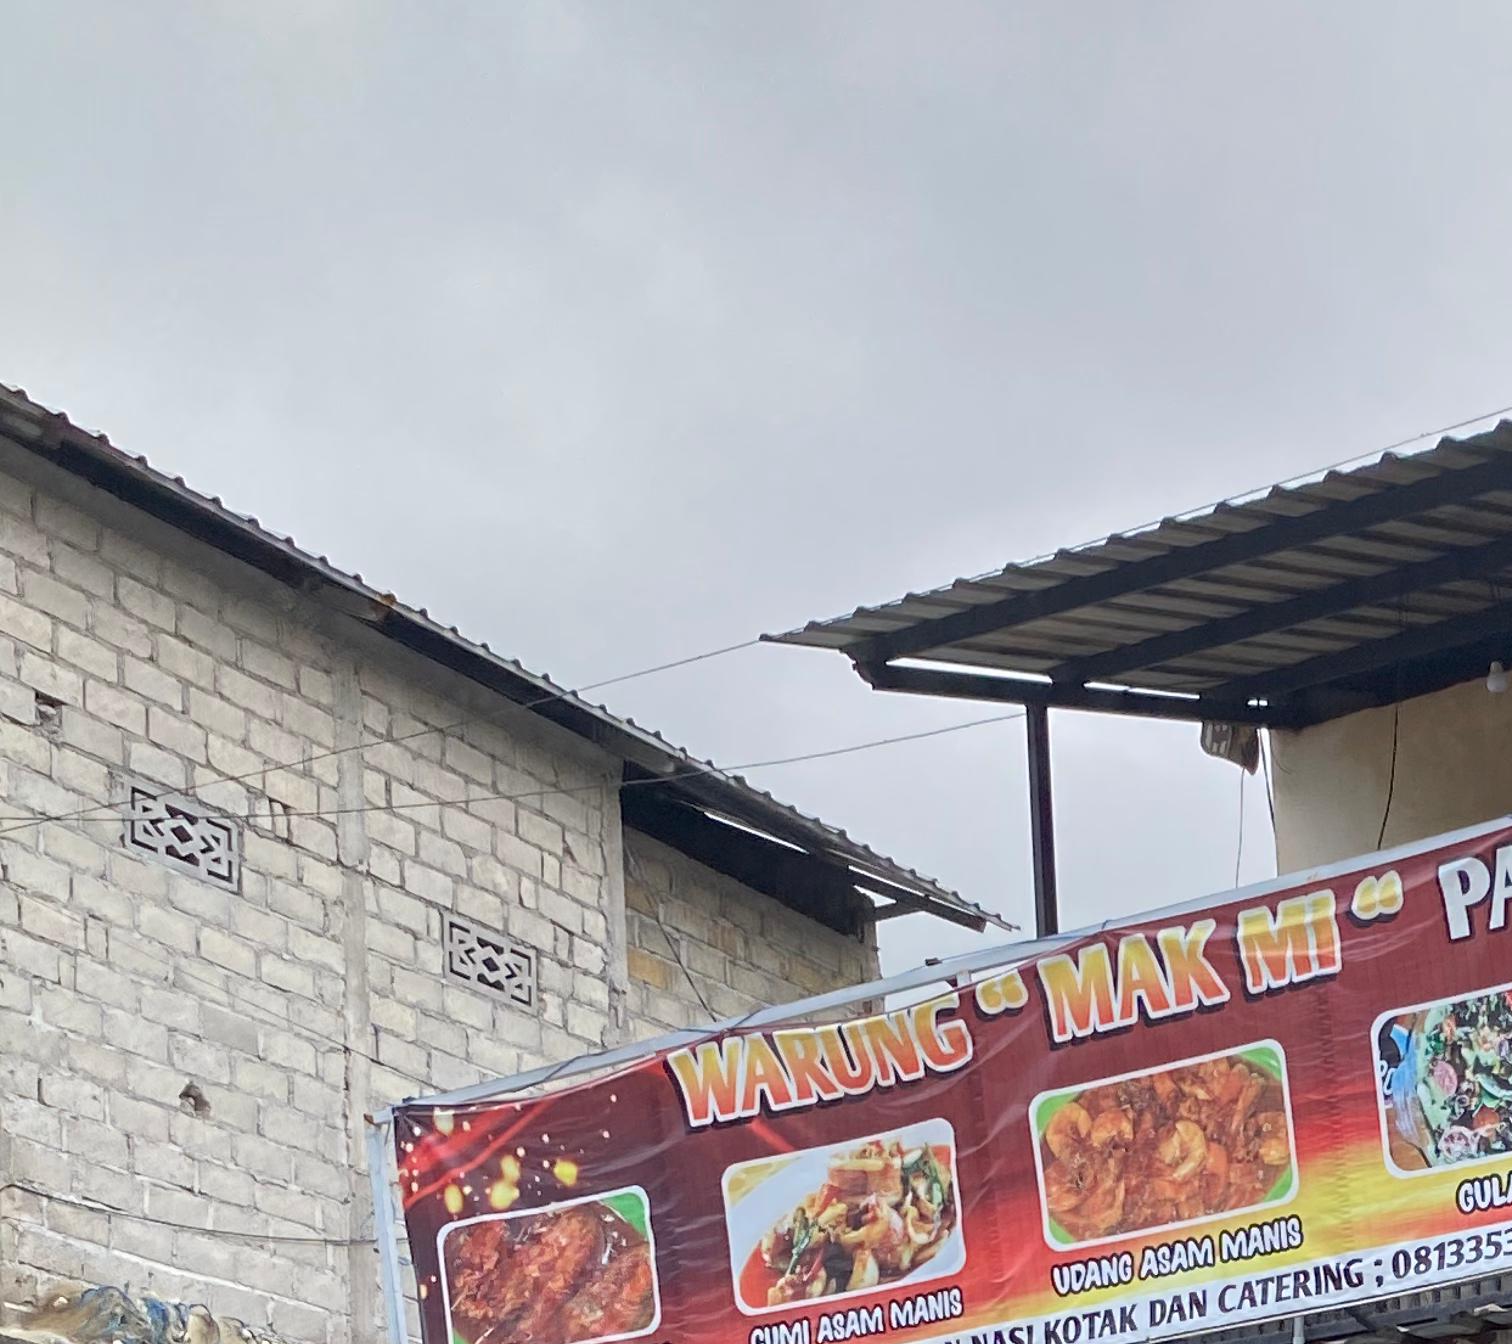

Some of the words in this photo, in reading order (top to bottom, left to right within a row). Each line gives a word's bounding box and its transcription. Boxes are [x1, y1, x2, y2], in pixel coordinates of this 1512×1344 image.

[668, 992, 973, 1128] WARUNG
[1052, 1256, 1133, 1296] UDANG
[1139, 1238, 1215, 1277] ASAM
[1220, 1217, 1302, 1263] MANIS
[1149, 1288, 1208, 1323] DAN
[1219, 1258, 1365, 1312] CATERING
[815, 1313, 885, 1344] ASAM
[890, 1288, 963, 1329] MANIS
